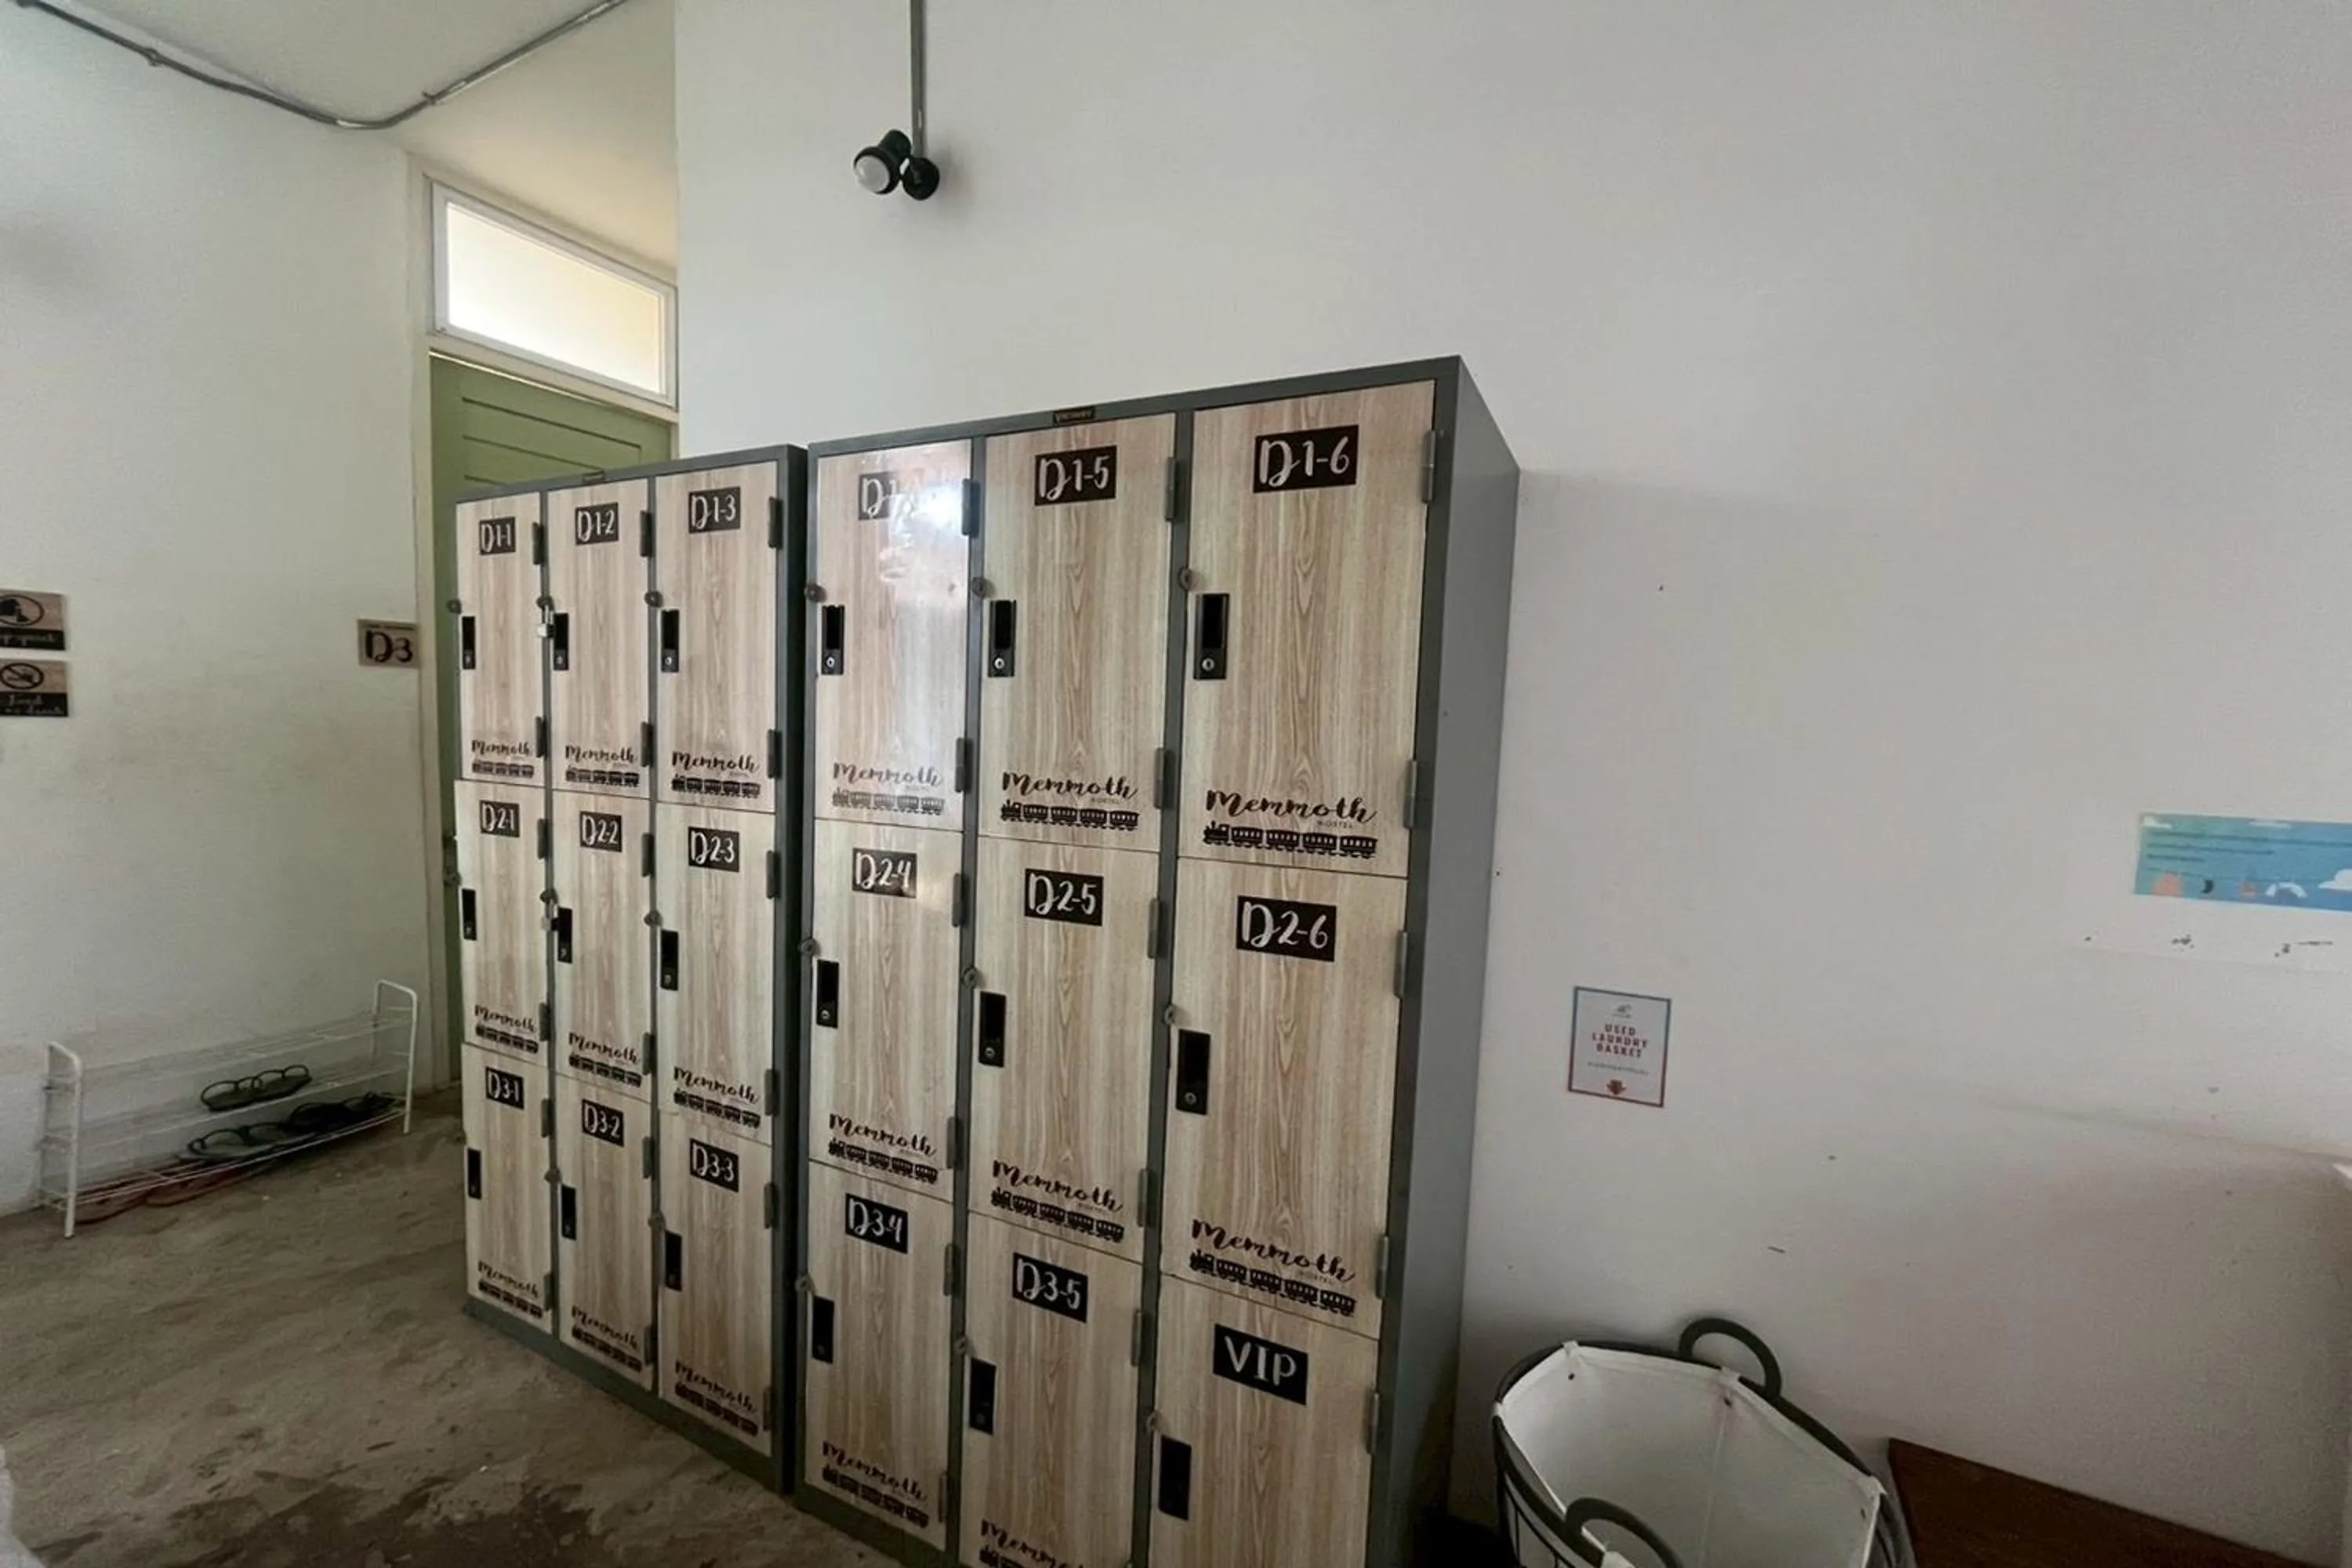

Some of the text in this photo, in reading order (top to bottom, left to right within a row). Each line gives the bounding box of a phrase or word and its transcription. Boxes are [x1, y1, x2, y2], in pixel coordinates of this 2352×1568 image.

[1039, 456, 1110, 502] D1-5
[1258, 436, 1349, 488] D1-6
[690, 493, 738, 530] D1-3
[861, 477, 916, 518] D1
[481, 522, 514, 553] D1-1
[577, 510, 616, 543] D1-2
[365, 629, 414, 664] D3
[471, 739, 532, 757] Memmoth
[564, 746, 639, 764] Memmoth
[671, 750, 760, 773] Memmoth
[833, 761, 944, 788] Memmoth
[1001, 771, 1139, 800] Memmoth
[1205, 789, 1378, 823] Memmoth
[581, 813, 620, 846] D2-2
[690, 829, 736, 865] D2-3
[854, 852, 912, 891] D2-4
[1028, 873, 1097, 916] D2-5
[1241, 902, 1329, 949] D2-6
[474, 1004, 539, 1034] Memmoth
[1605, 1023, 1636, 1037] USED
[568, 1033, 641, 1065] Memmoth
[1592, 1032, 1649, 1048] LAUNDRY
[488, 1069, 521, 1105] D3-1
[673, 1066, 760, 1104] Memmoth
[584, 1102, 621, 1140] D3-2
[828, 1112, 938, 1158] Memmoth
[691, 1143, 736, 1183] D3-3
[993, 1159, 1124, 1213] Memmoth
[848, 1196, 904, 1244] D3-4
[1191, 1218, 1356, 1283] Memmoth
[1017, 1258, 1082, 1311] D3-5
[1224, 1335, 1298, 1386] VIP
